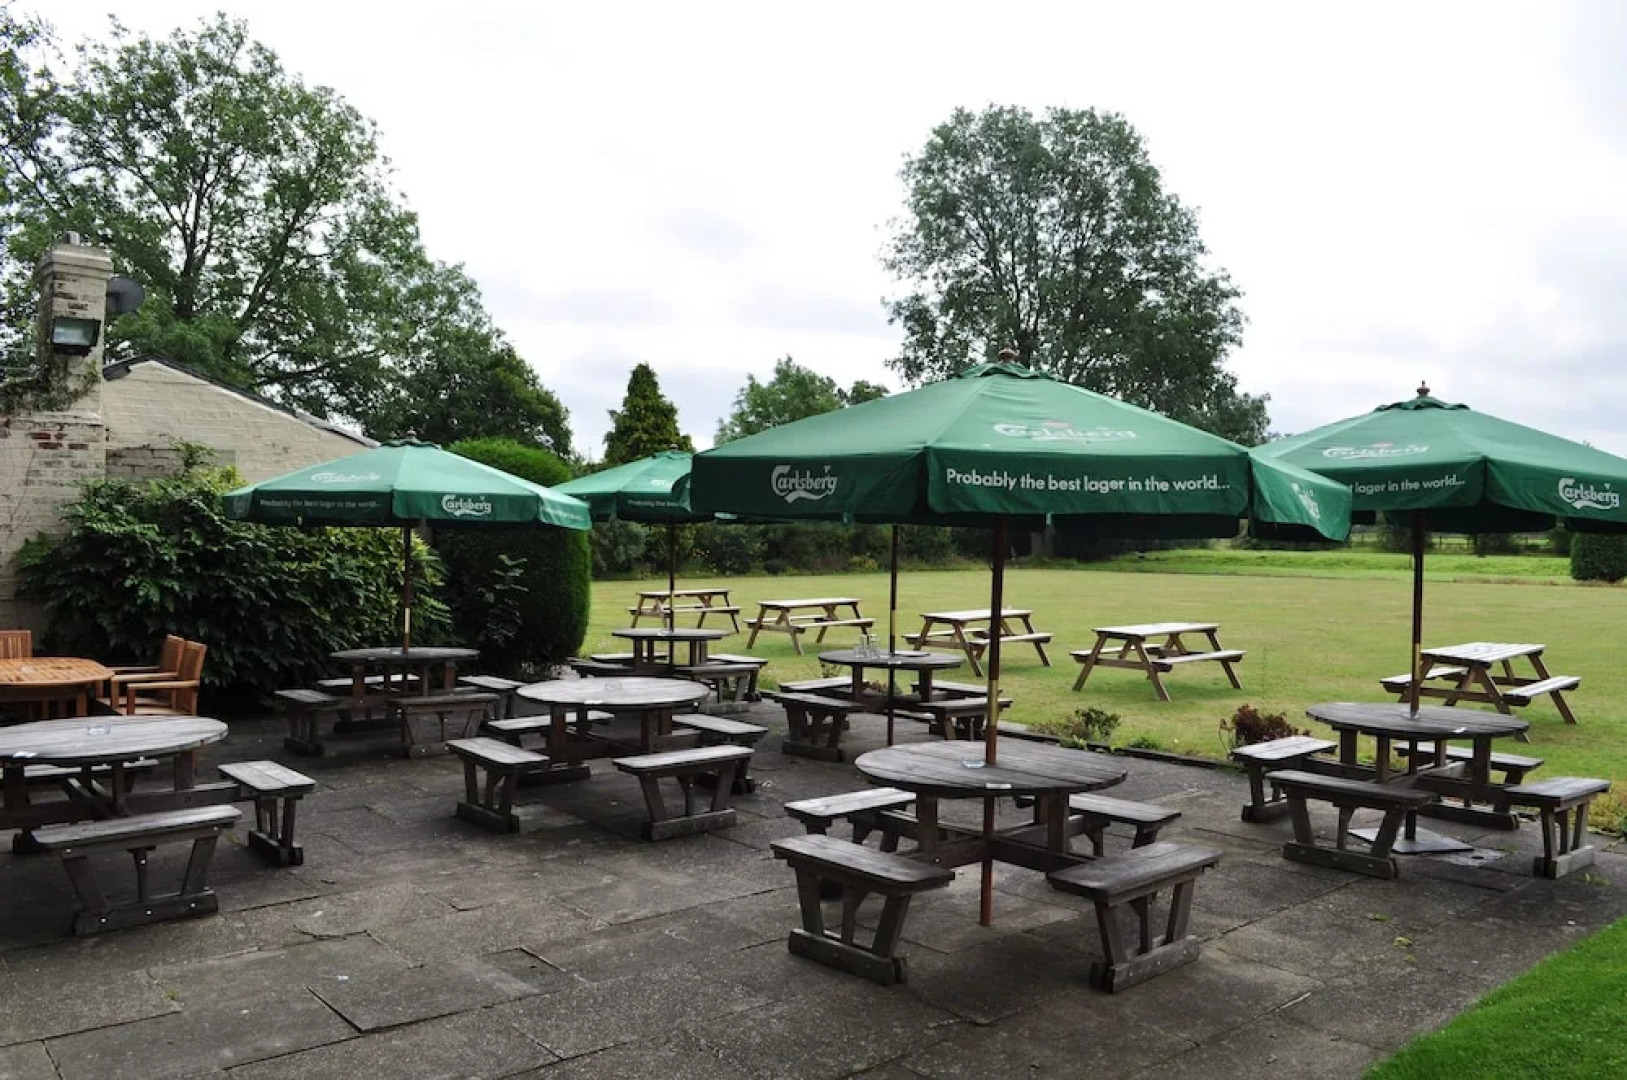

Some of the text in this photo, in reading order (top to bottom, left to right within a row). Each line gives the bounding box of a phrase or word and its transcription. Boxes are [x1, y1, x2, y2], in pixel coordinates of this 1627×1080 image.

[770, 464, 838, 503] Carlsberg
[946, 467, 1231, 494] Probably the best lager in the world...
[1354, 480, 1386, 495] lager
[1387, 480, 1399, 492] in
[1400, 478, 1420, 491] the
[1422, 474, 1466, 489] world...
[1558, 477, 1620, 510] Carlsberg
[441, 494, 492, 517] Carlsberg
